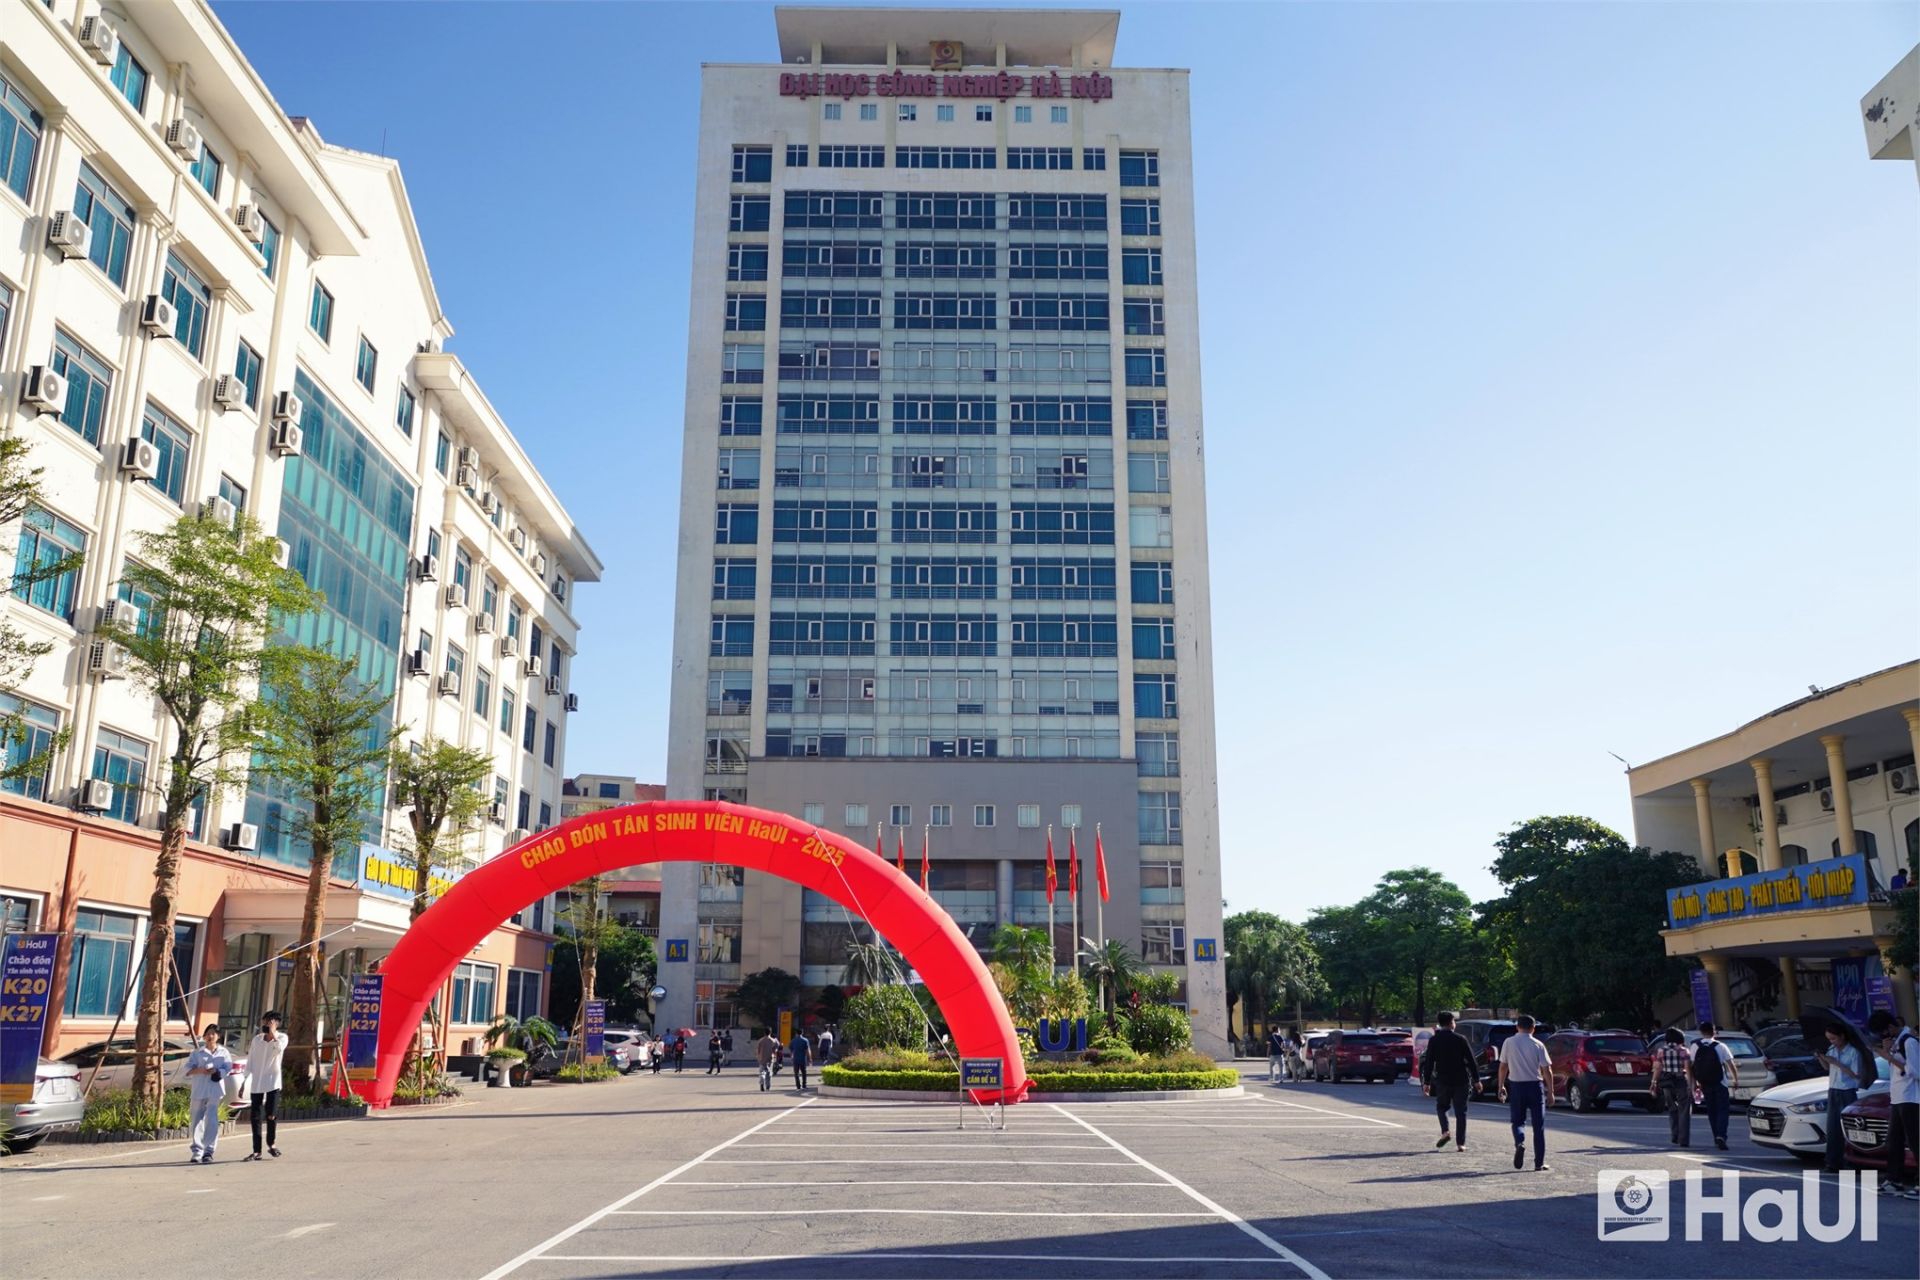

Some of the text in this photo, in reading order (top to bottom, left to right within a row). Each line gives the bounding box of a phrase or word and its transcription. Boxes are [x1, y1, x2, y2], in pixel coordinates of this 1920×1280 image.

[780, 69, 1113, 103] ĐẠI HỌC CÔNG NGHIỆP HÀ NỘI
[520, 836, 566, 870] CHÀO
[570, 822, 607, 849] ĐÓN
[614, 814, 649, 836] TÂN
[656, 813, 697, 831] SINH
[704, 813, 743, 834] VIÊN
[749, 821, 789, 845] HaUI
[801, 837, 847, 867] 2025
[1752, 878, 1774, 907] PHÁT
[26, 940, 47, 949] HaUI
[3, 978, 47, 994] K20
[0, 1005, 43, 1021] K27
[352, 1003, 379, 1013] K20
[351, 1020, 378, 1030] K27
